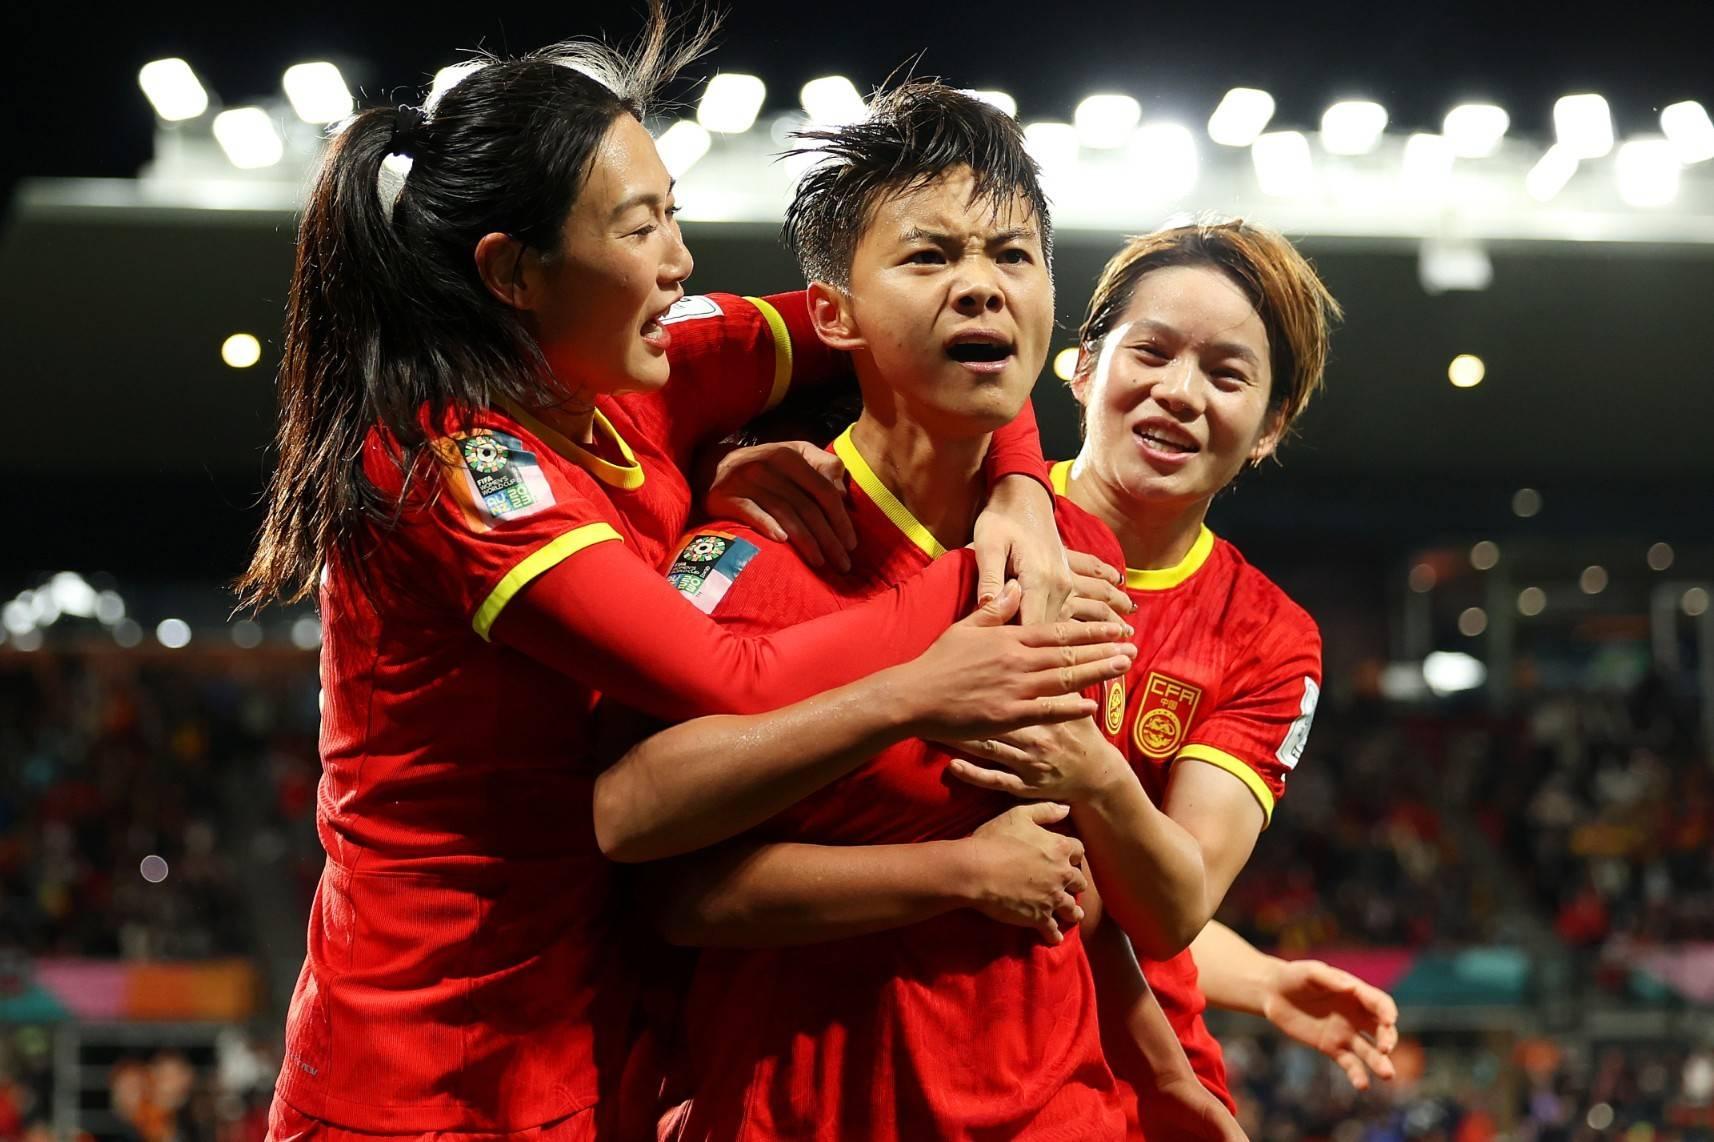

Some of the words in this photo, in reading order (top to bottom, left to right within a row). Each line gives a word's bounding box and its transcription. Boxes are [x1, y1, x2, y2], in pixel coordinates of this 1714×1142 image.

[477, 476, 493, 486] FIFA
[482, 483, 504, 496] WORLD
[503, 478, 516, 487] CUP
[1150, 679, 1196, 703] CFA
